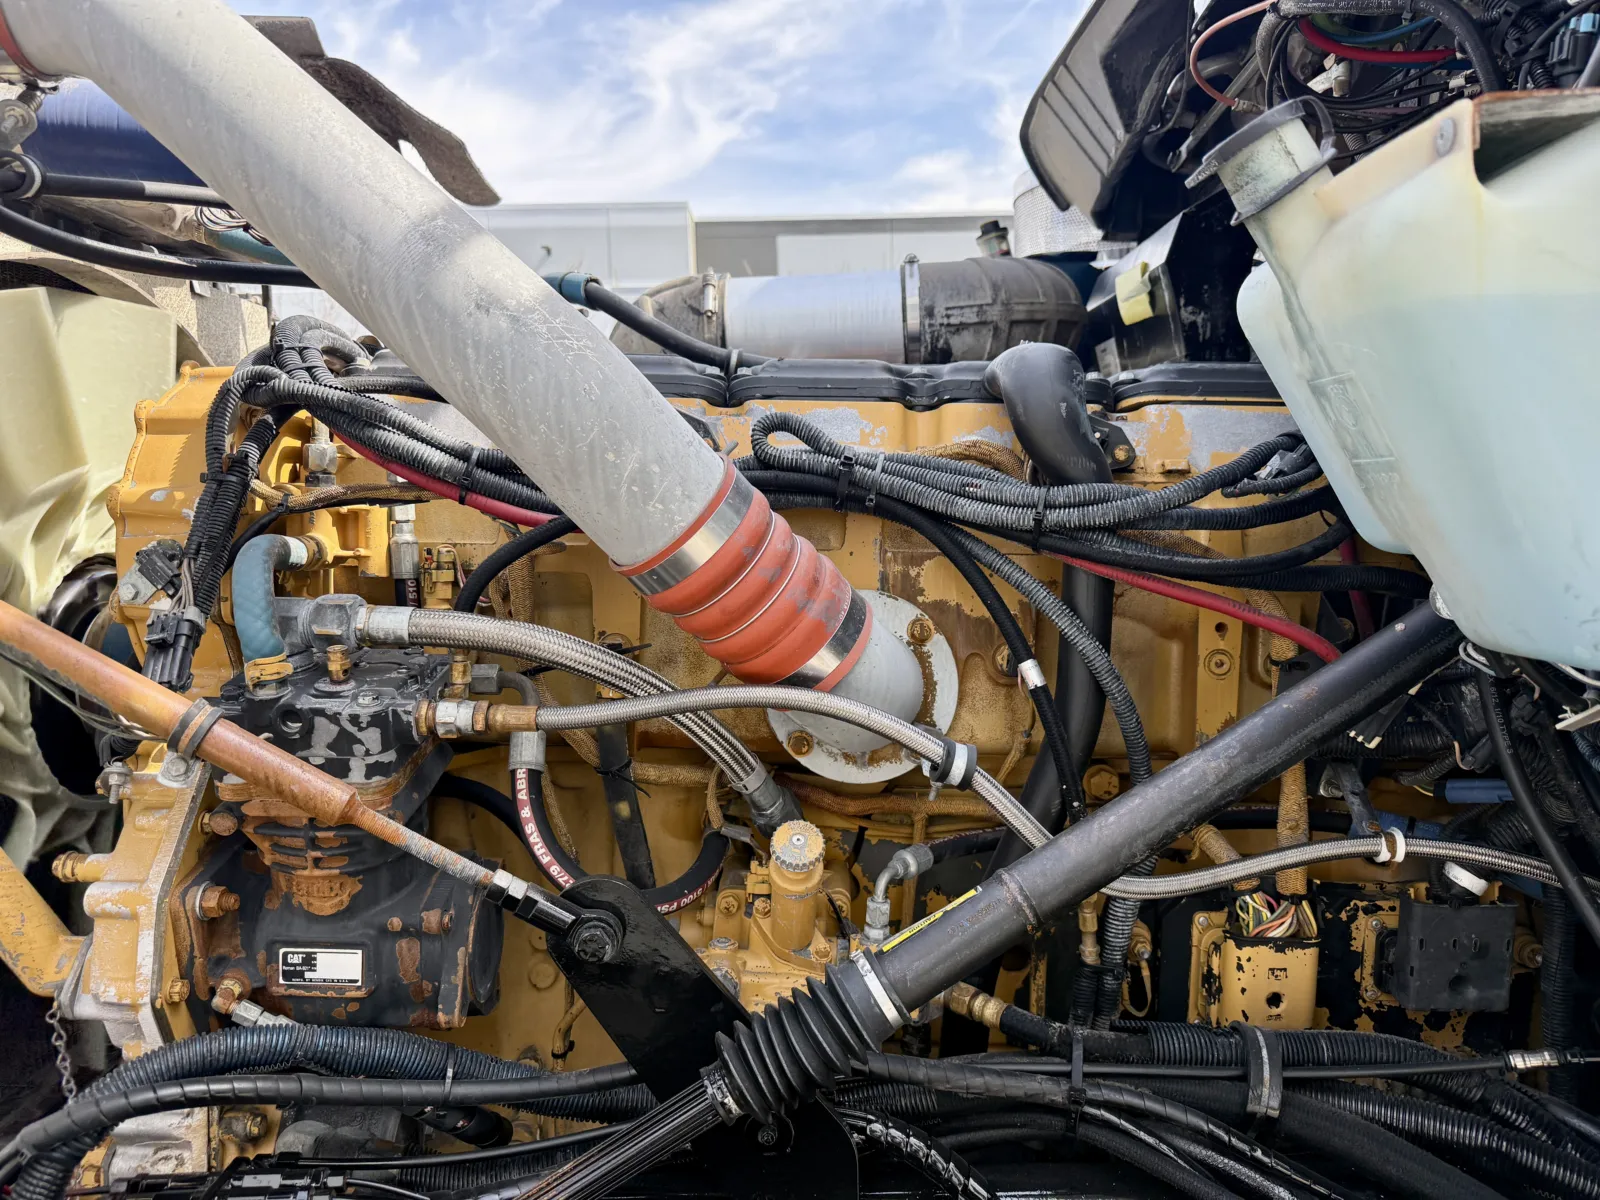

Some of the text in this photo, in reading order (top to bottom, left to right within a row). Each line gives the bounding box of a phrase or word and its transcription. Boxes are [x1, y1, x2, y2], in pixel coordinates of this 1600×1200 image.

[408, 579, 417, 599] 510
[1499, 724, 1512, 748] TYPE
[516, 768, 528, 800] ABR
[520, 805, 531, 818] &
[525, 822, 551, 864] FRAS
[680, 887, 703, 907] 5100
[287, 953, 303, 964] CAT
